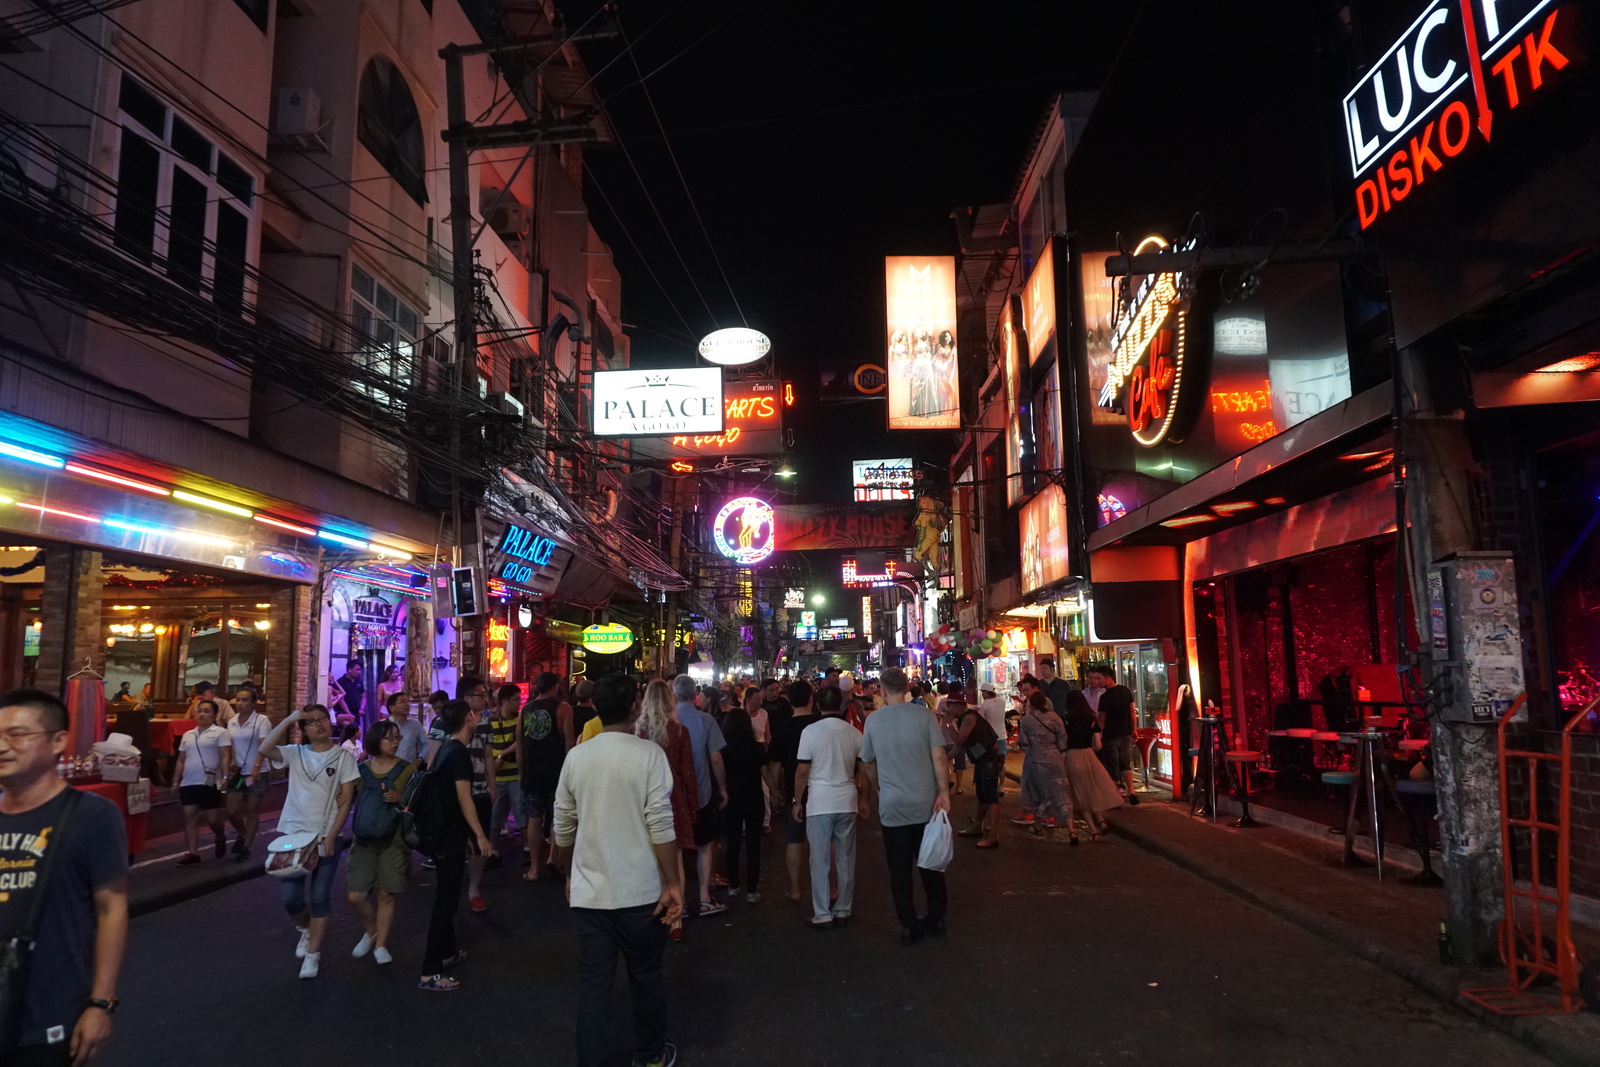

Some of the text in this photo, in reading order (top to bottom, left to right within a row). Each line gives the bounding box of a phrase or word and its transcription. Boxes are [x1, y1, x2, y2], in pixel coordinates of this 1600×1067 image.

[604, 396, 715, 420] PALACE
[846, 510, 911, 538] HOUSE
[502, 524, 557, 567] PALACE
[354, 599, 393, 618] PALACE
[608, 633, 624, 641] BAR
